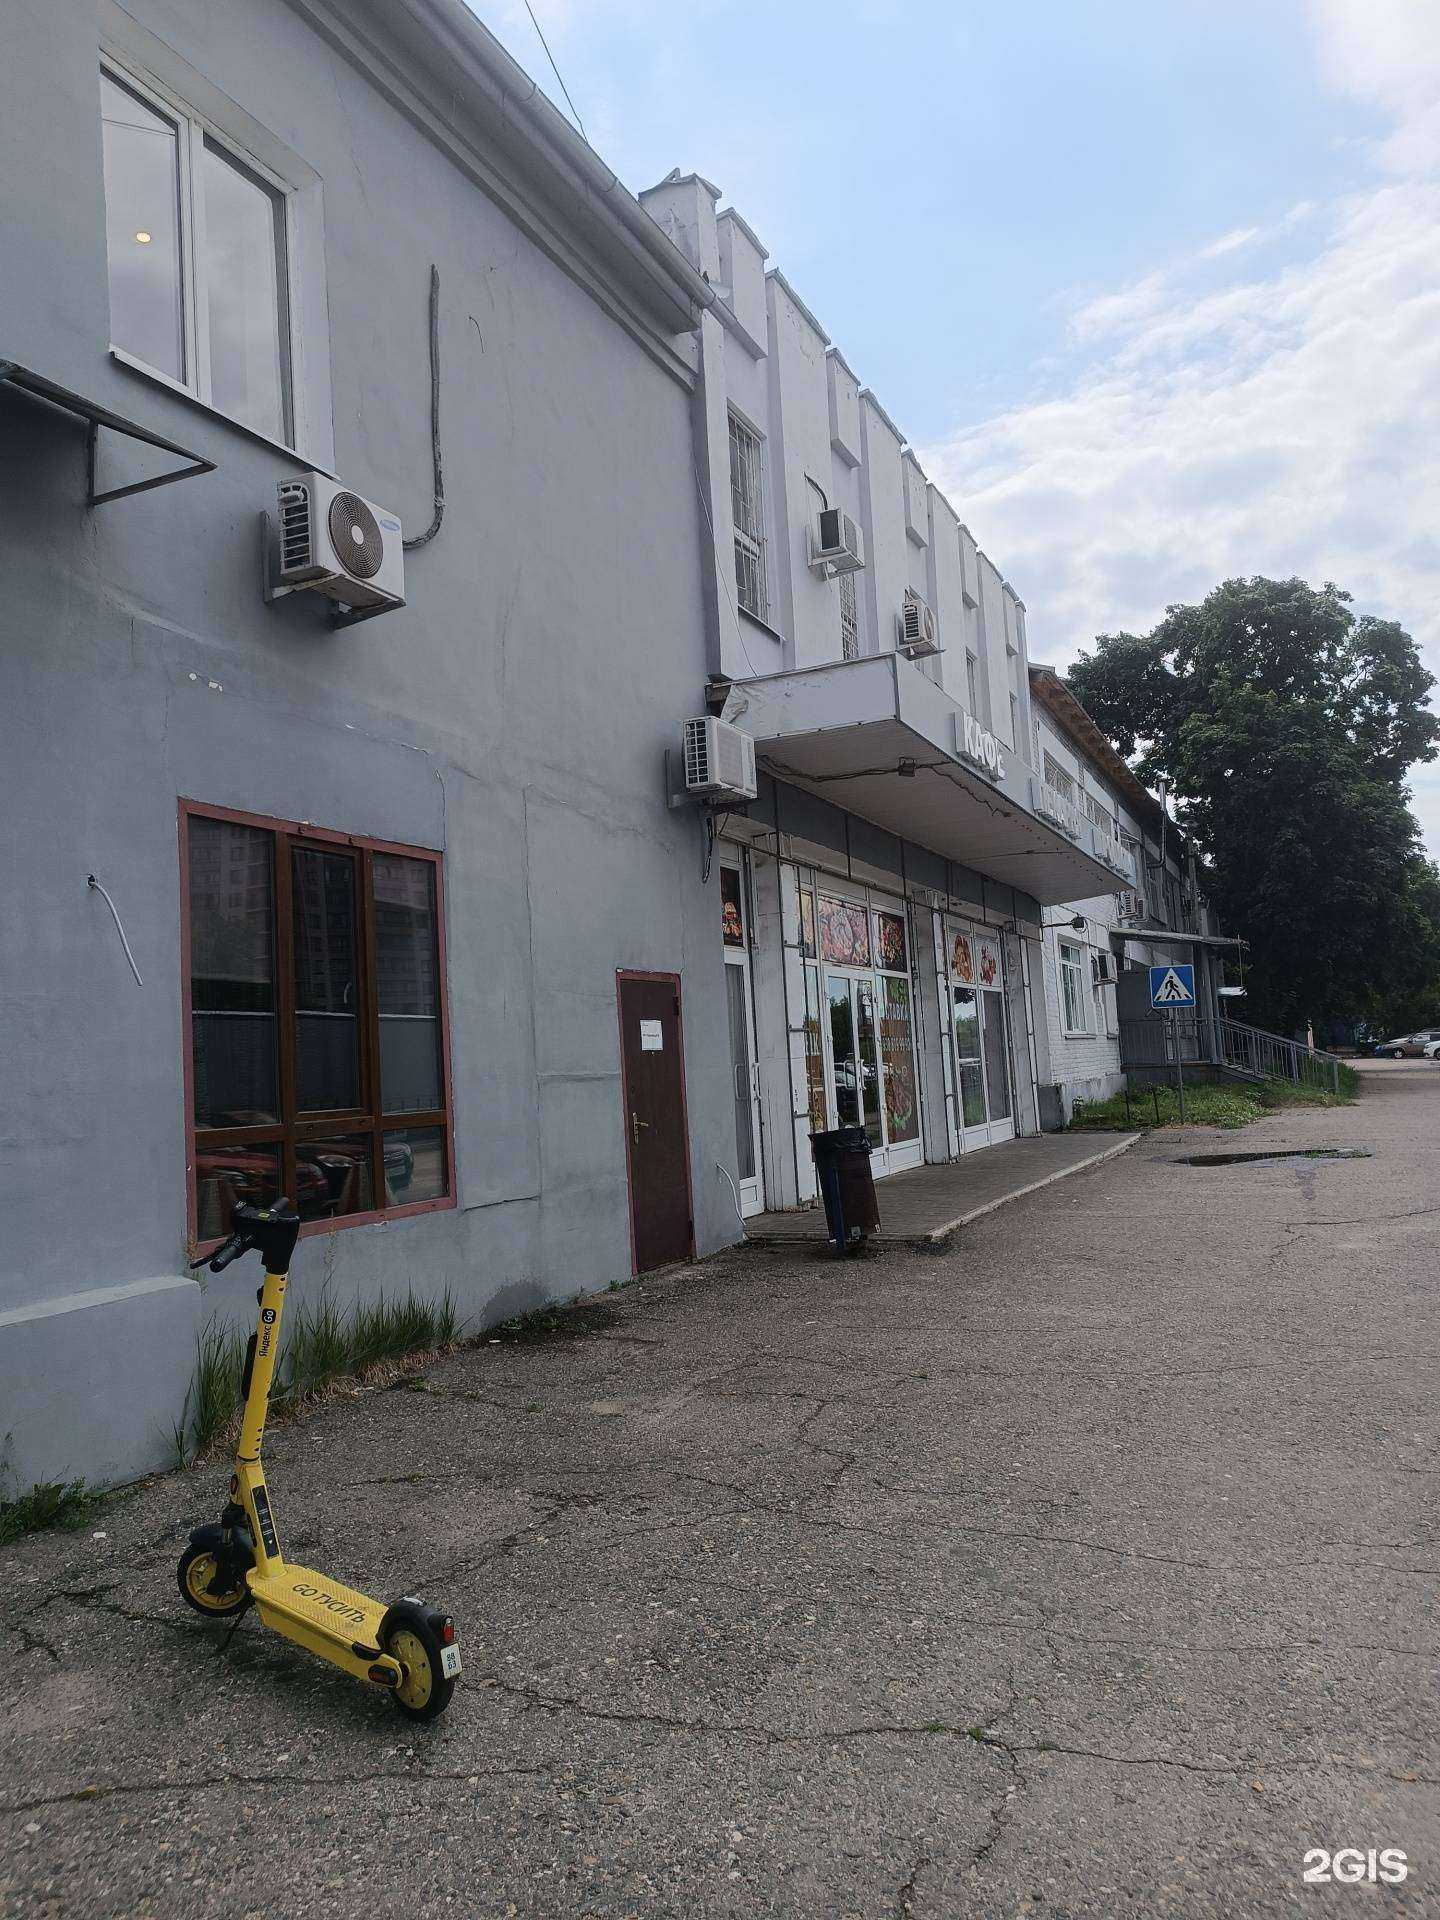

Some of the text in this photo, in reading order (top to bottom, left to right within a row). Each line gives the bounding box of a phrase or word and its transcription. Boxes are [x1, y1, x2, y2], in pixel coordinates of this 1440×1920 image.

[259, 1310, 274, 1357] Яндекс Go
[292, 1583, 366, 1623] GO ТУСИТЬ
